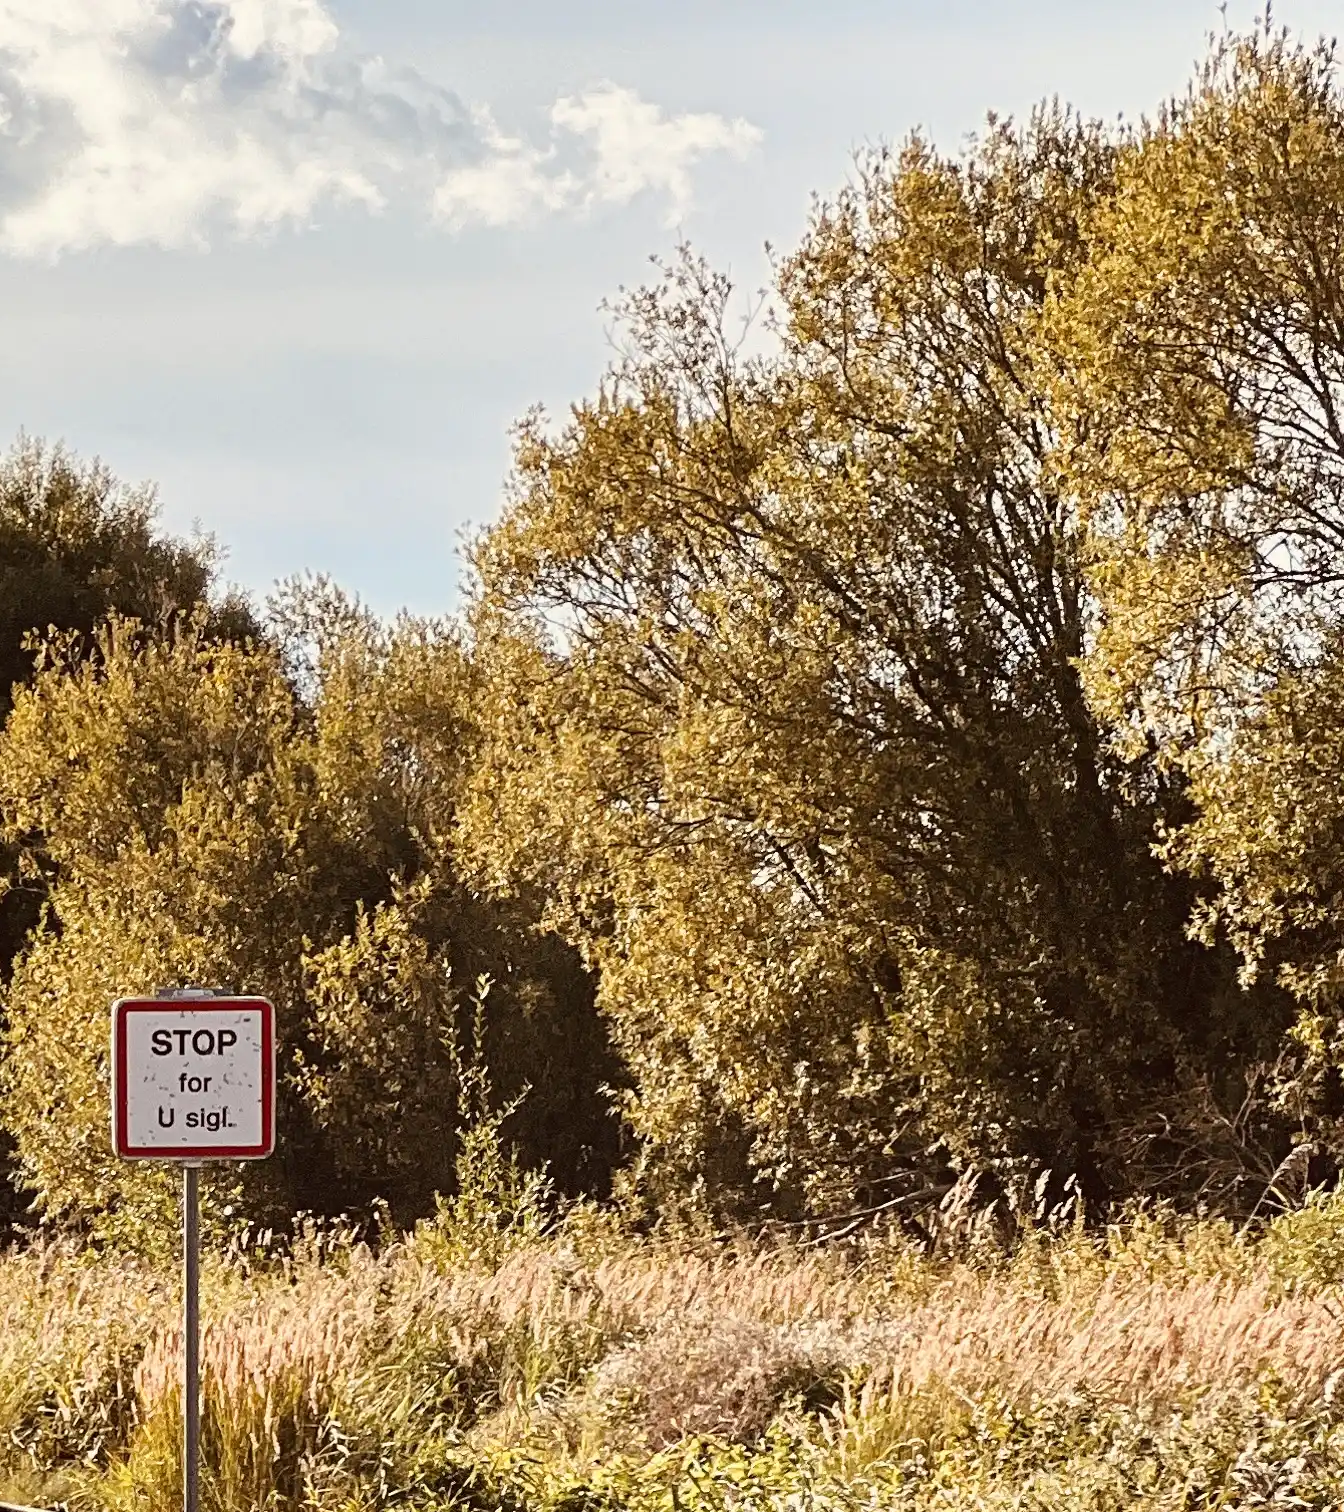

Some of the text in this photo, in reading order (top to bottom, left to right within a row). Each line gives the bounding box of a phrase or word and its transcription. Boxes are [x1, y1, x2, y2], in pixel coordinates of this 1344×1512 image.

[150, 1029, 238, 1057] STOP
[178, 1072, 213, 1093] for
[158, 1105, 234, 1132] U sigl.
